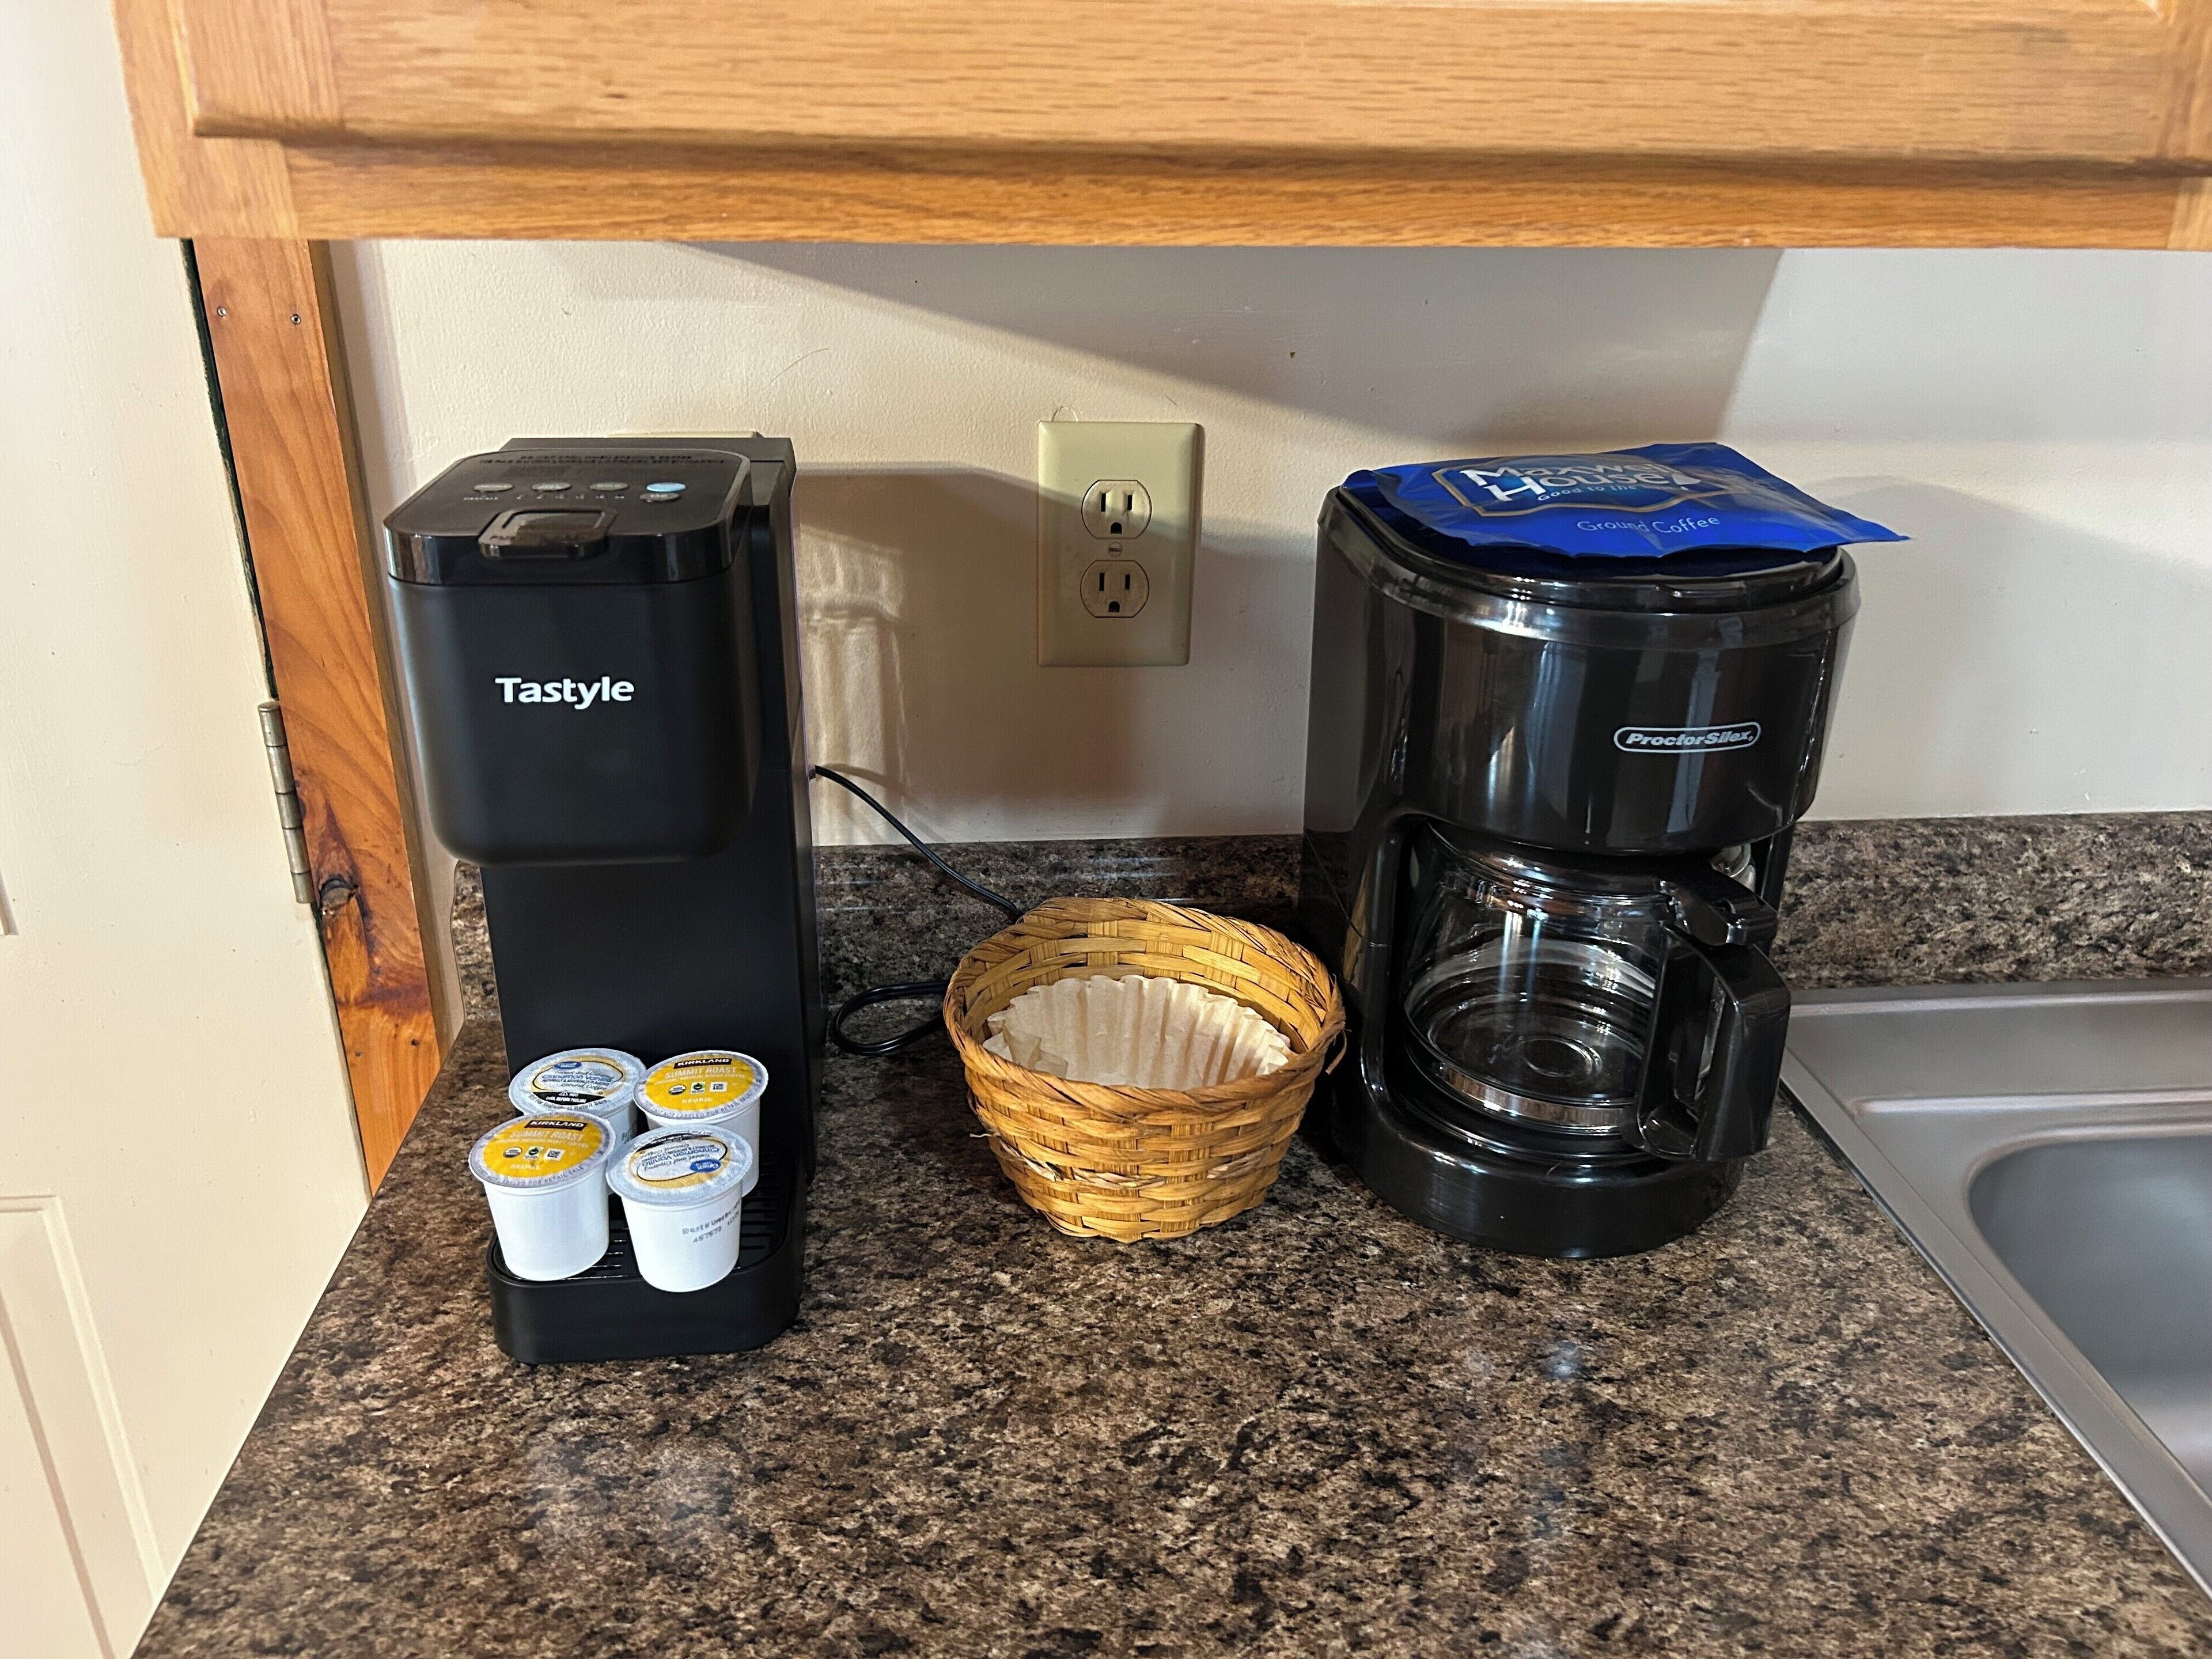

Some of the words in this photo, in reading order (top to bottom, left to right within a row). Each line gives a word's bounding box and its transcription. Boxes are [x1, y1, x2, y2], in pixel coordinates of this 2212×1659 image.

[1483, 473, 1671, 502] House
[1537, 487, 1582, 501] Good
[1577, 520, 1650, 532] Ground
[1652, 516, 1721, 535] Coffee
[494, 676, 635, 710] Tastyle
[1625, 730, 1752, 746] ProctorSilex
[677, 1058, 730, 1066] KIRKLAND
[585, 1074, 613, 1082] Vanilla
[665, 1068, 703, 1080] SUMMIT
[720, 1101, 739, 1112] RETAIL
[531, 1120, 585, 1128] KIRKLAND
[550, 1130, 585, 1141] ROAST
[673, 1146, 720, 1157] Cinnamon
[642, 1155, 672, 1167] Vanilla
[544, 1172, 568, 1184] RETAIL
[568, 1165, 585, 1176] SALE
[682, 1224, 703, 1234] Best
